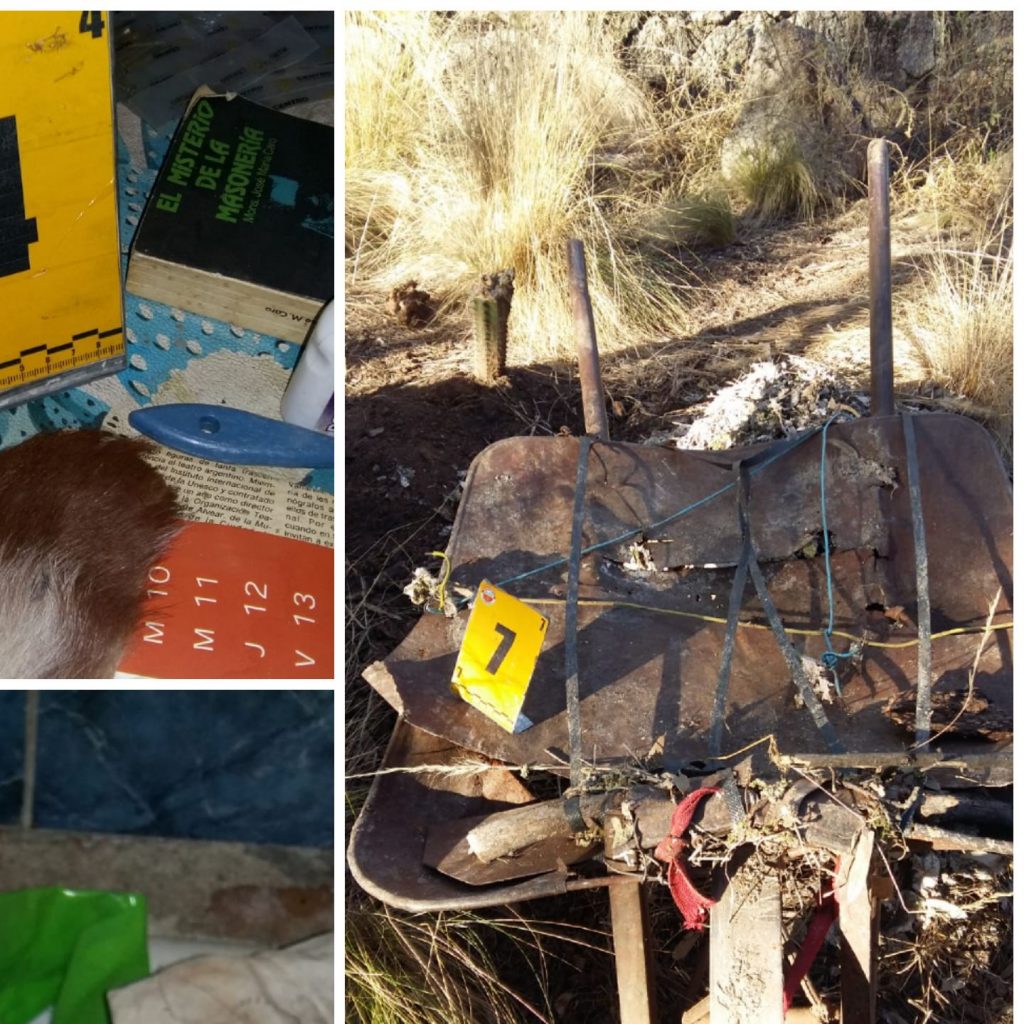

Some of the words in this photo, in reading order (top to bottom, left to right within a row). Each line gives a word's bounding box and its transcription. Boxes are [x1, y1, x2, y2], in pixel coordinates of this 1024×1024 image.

[79, 11, 104, 38] 4
[167, 99, 214, 187] MISTERIO
[204, 139, 230, 164] LA
[195, 165, 222, 190] DE
[215, 126, 264, 224] MASONERÍA
[157, 193, 182, 213] EL
[265, 307, 288, 317] Caro
[178, 461, 202, 472] teatro
[188, 479, 219, 492] Unesco
[227, 489, 275, 505] contratado
[214, 494, 238, 505] como
[240, 499, 274, 514] director
[284, 522, 317, 535] cuando
[309, 518, 325, 528] Por
[147, 566, 170, 598] 10
[194, 577, 218, 606] 11
[244, 581, 267, 615] 12
[293, 592, 316, 625] 13
[143, 621, 165, 644] M
[539, 617, 546, 631] 7
[193, 628, 215, 651] M
[244, 642, 266, 658] J
[485, 622, 517, 675] 7
[295, 650, 316, 667] V
